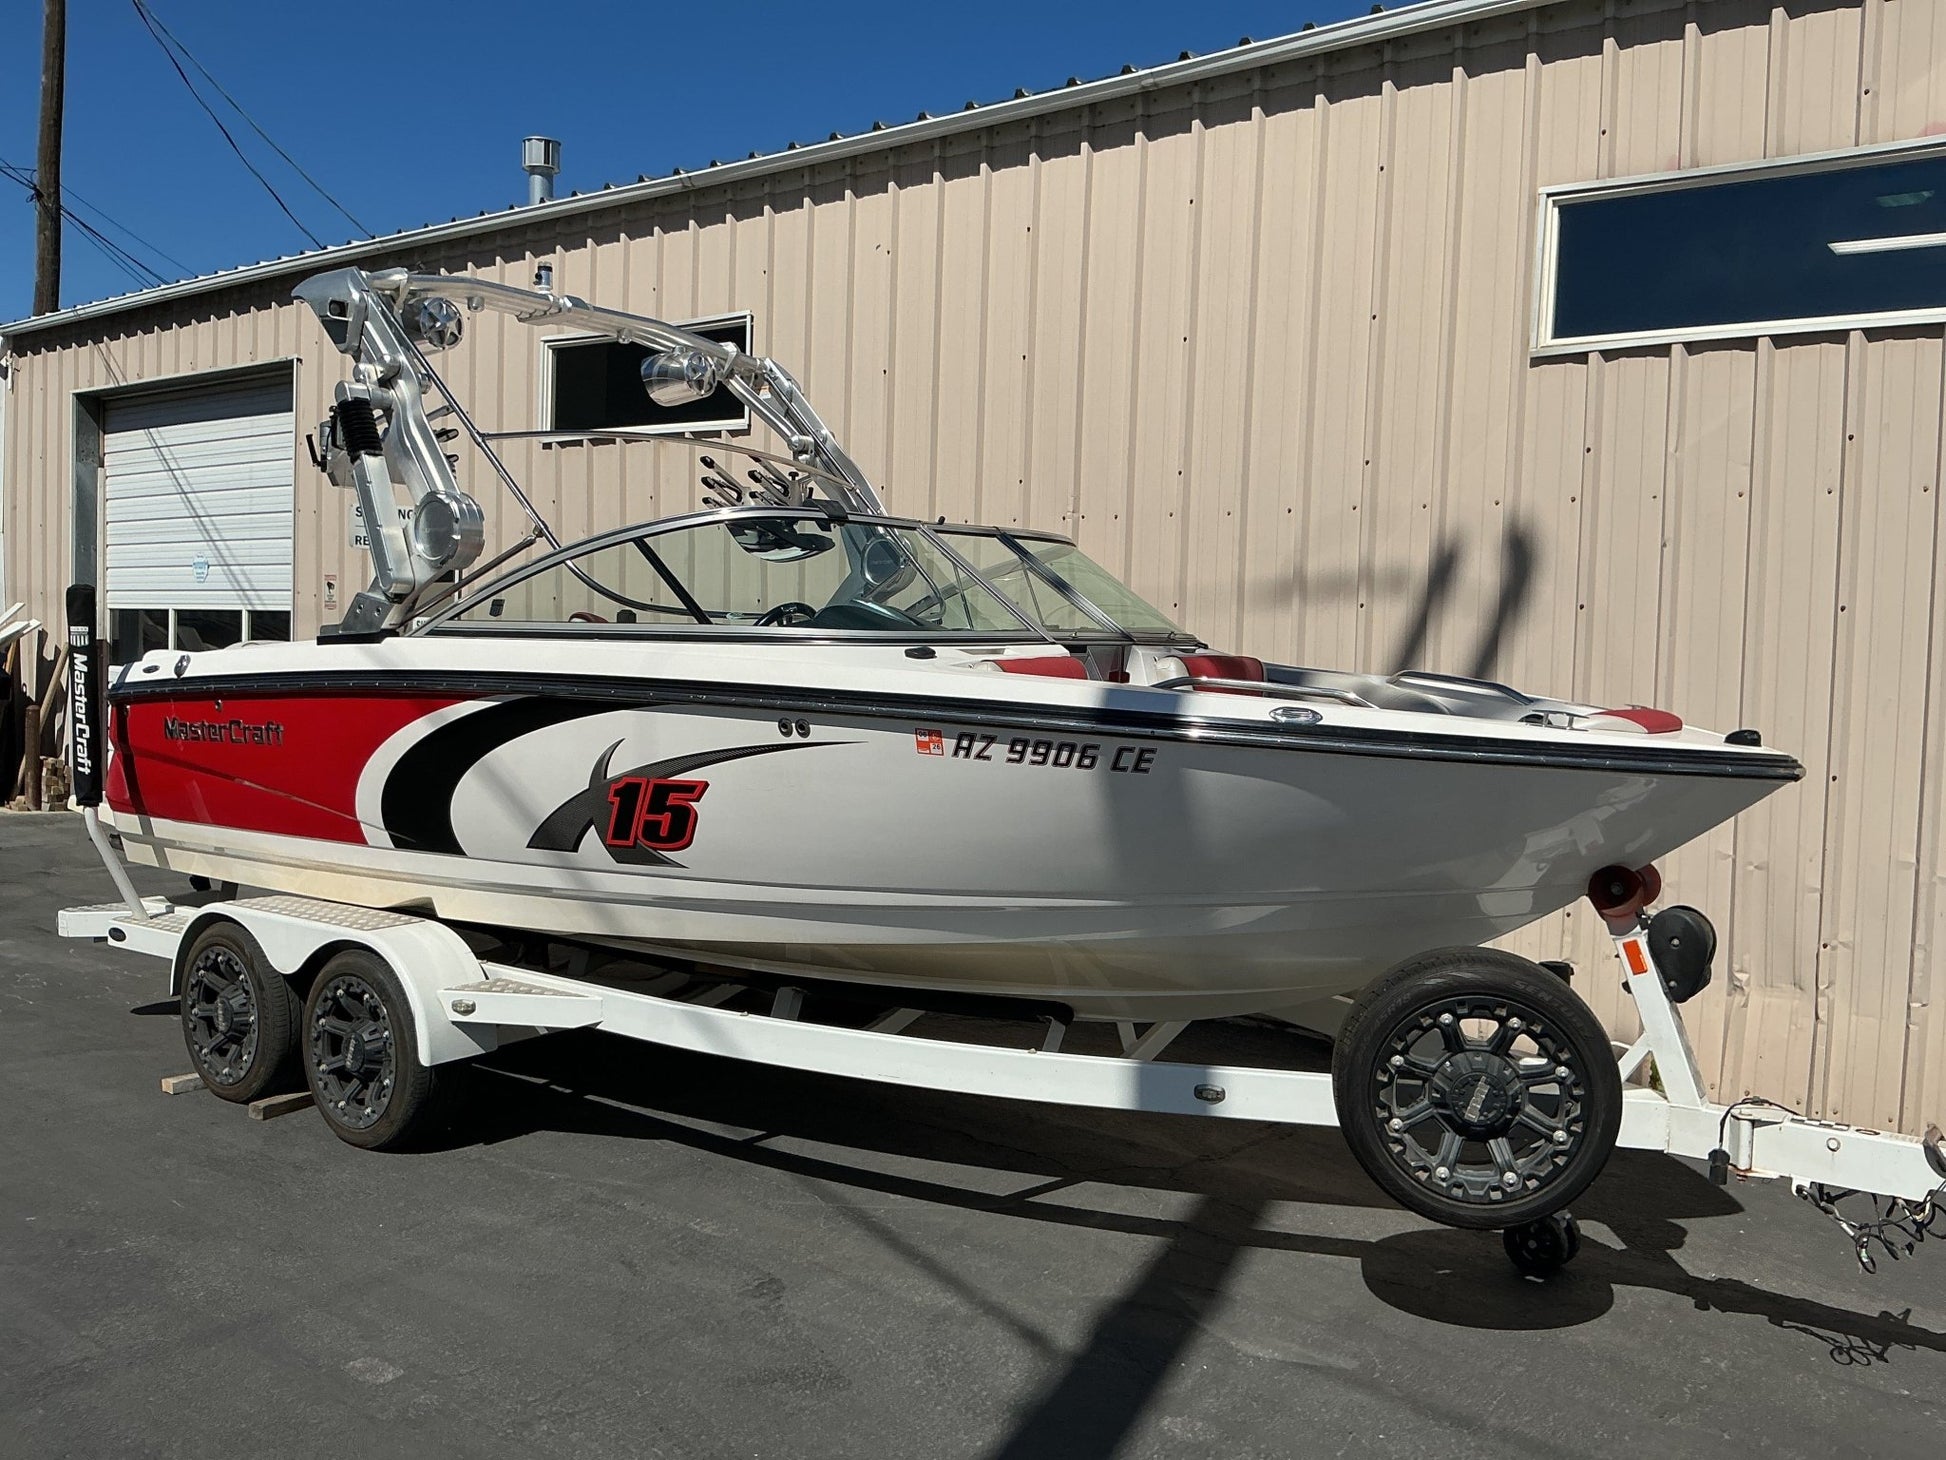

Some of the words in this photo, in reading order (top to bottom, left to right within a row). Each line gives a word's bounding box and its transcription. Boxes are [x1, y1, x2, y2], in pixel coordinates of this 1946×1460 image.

[73, 653, 92, 775] MasterCraft
[164, 716, 284, 745] MasterCraft
[951, 731, 998, 762] AZ
[1005, 736, 1100, 771] 9906
[1110, 745, 1158, 775] CE
